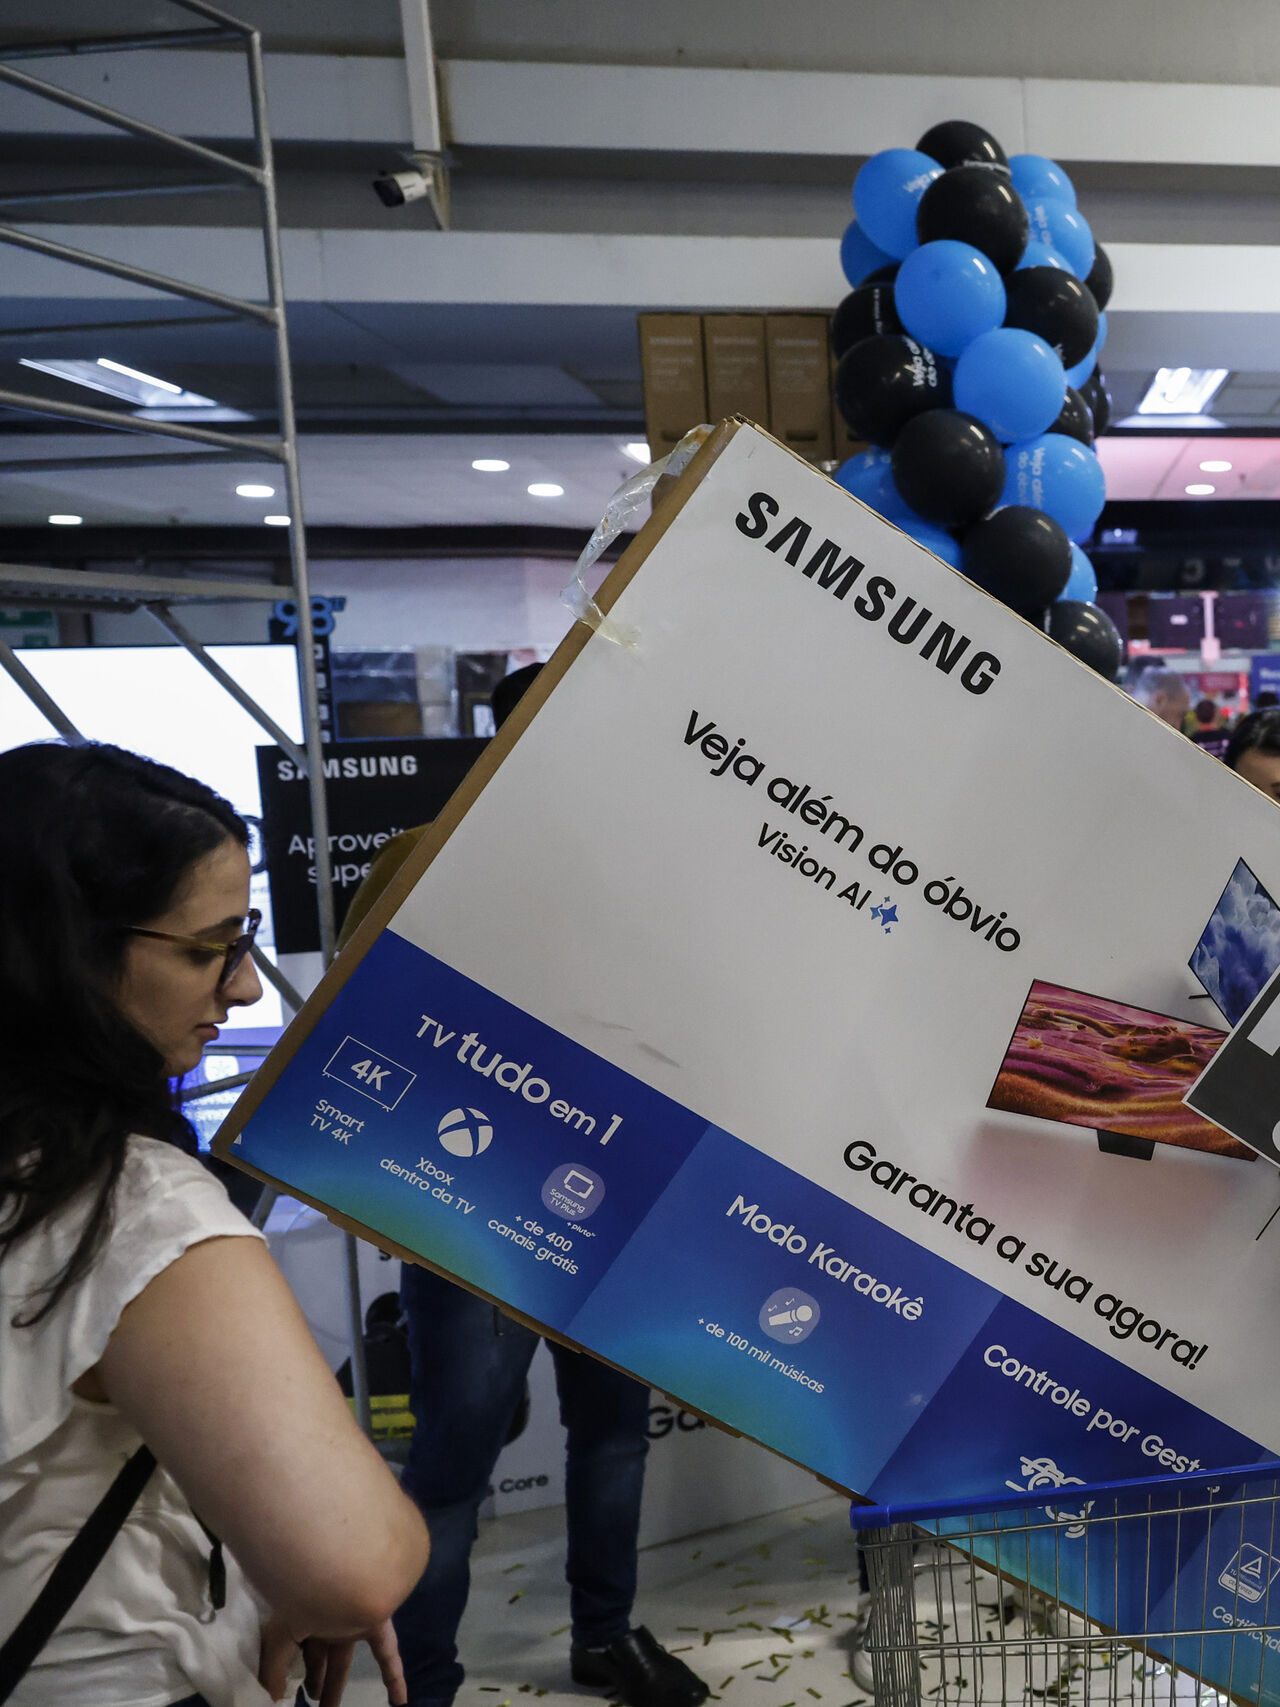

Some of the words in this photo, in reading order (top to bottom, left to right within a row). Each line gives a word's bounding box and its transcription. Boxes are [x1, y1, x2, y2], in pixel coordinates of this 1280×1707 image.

[735, 491, 1002, 695] SAMSUNG
[277, 754, 418, 781] SMSUNG
[684, 709, 766, 786] Veja
[766, 777, 865, 853] além
[868, 845, 919, 885] do
[923, 876, 1021, 952] óbvio
[757, 822, 838, 891] Vision
[836, 881, 873, 910] AI
[350, 1058, 393, 1092] 4K
[415, 1014, 456, 1049] TV
[455, 1031, 551, 1104] tudo
[550, 1099, 597, 1136] em
[599, 1113, 624, 1146] 1
[310, 1113, 332, 1132] TV
[331, 1127, 353, 1145] 4K
[315, 1099, 365, 1133] Smart
[379, 1158, 430, 1191] dentro
[431, 1187, 454, 1205] da
[455, 1197, 477, 1215] TV
[415, 1156, 455, 1186] Xbox
[549, 1197, 562, 1207] TV
[487, 1219, 537, 1251] canais
[534, 1247, 579, 1275] grátis
[523, 1220, 545, 1236] de
[545, 1231, 573, 1252] 400
[725, 1194, 808, 1256] Modo
[807, 1241, 925, 1322] Karaokê
[842, 1139, 997, 1247] Garanta
[996, 1234, 1027, 1265] a
[1024, 1247, 1094, 1304] sua
[1092, 1287, 1210, 1371] agora!
[705, 1322, 726, 1338] de
[725, 1331, 749, 1351] 100
[747, 1345, 772, 1364] mil
[769, 1357, 825, 1394] músicas
[982, 1343, 1092, 1420] Controle
[1085, 1408, 1143, 1445] por
[499, 1473, 549, 1493] Core
